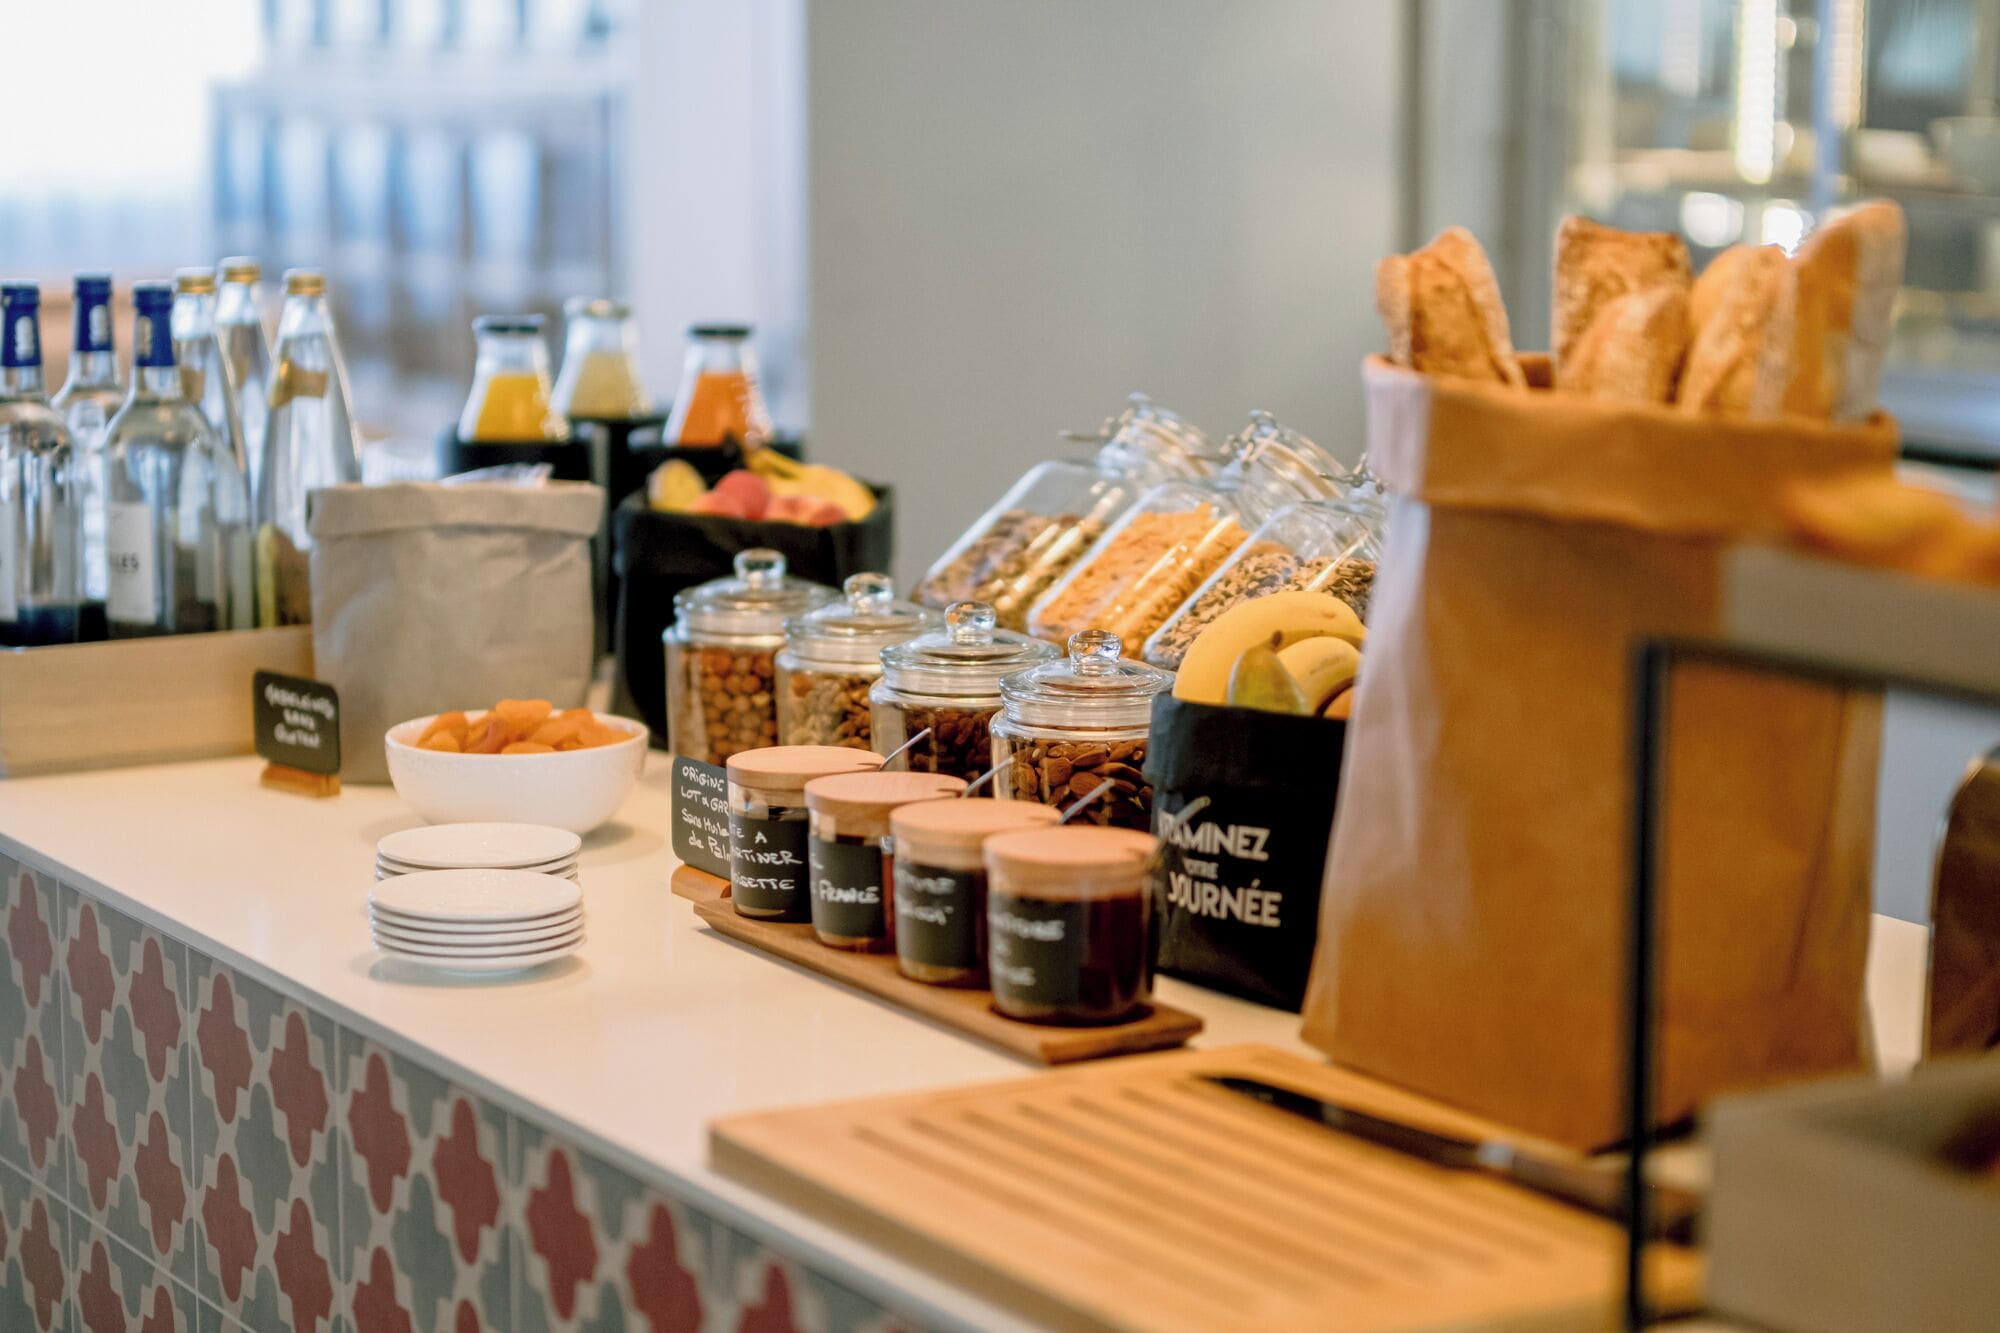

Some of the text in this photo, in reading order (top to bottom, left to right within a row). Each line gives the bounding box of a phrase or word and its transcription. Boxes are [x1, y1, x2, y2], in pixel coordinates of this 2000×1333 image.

[688, 830, 704, 849] de
[755, 831, 768, 844] A
[1167, 871, 1283, 928] JOURNÉE
